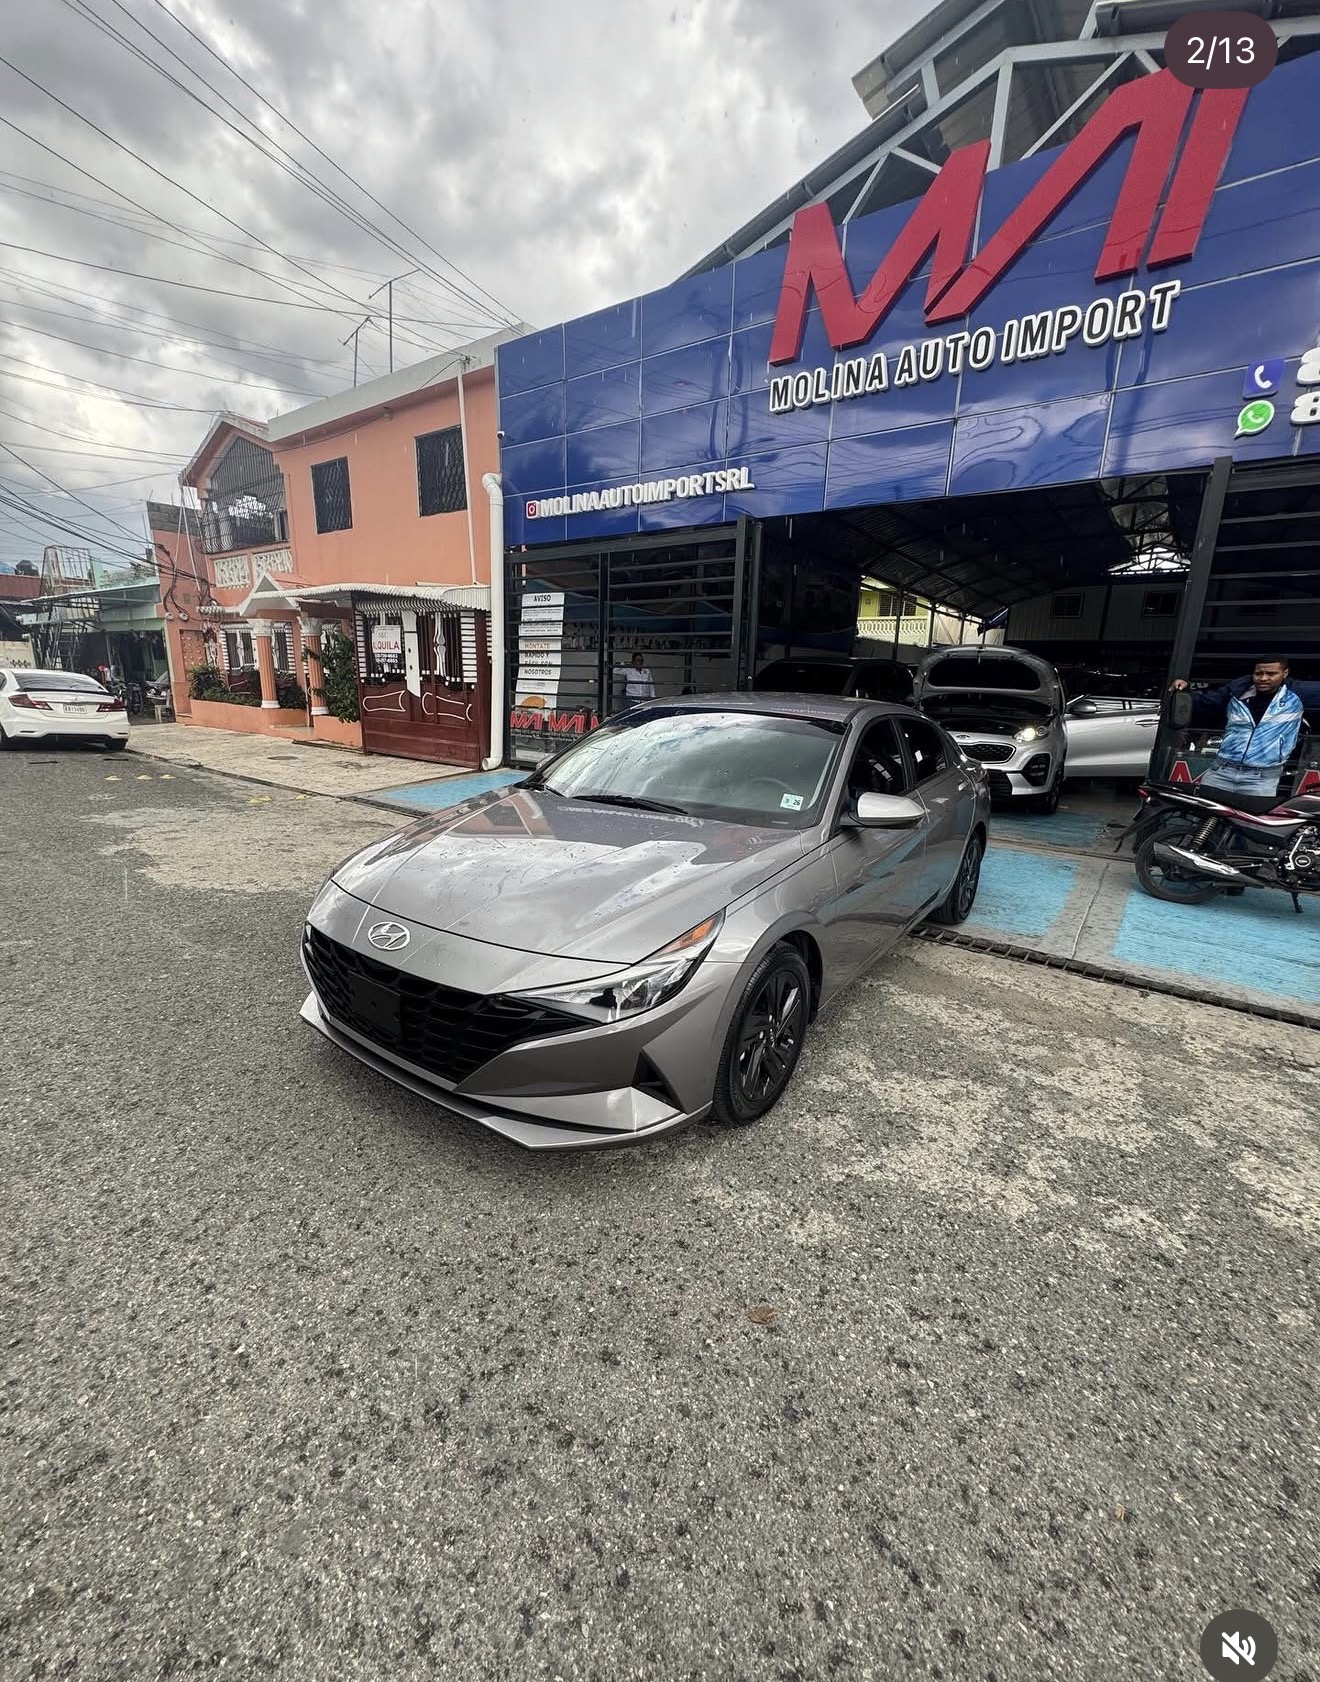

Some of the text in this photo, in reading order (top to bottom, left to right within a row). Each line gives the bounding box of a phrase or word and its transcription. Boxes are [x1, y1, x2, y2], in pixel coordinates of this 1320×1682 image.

[768, 280, 1181, 413] MOLINA AUTO IMPORT
[540, 467, 755, 518] MOLINAAUTOIMPORTSRL
[533, 594, 551, 602] AVISO
